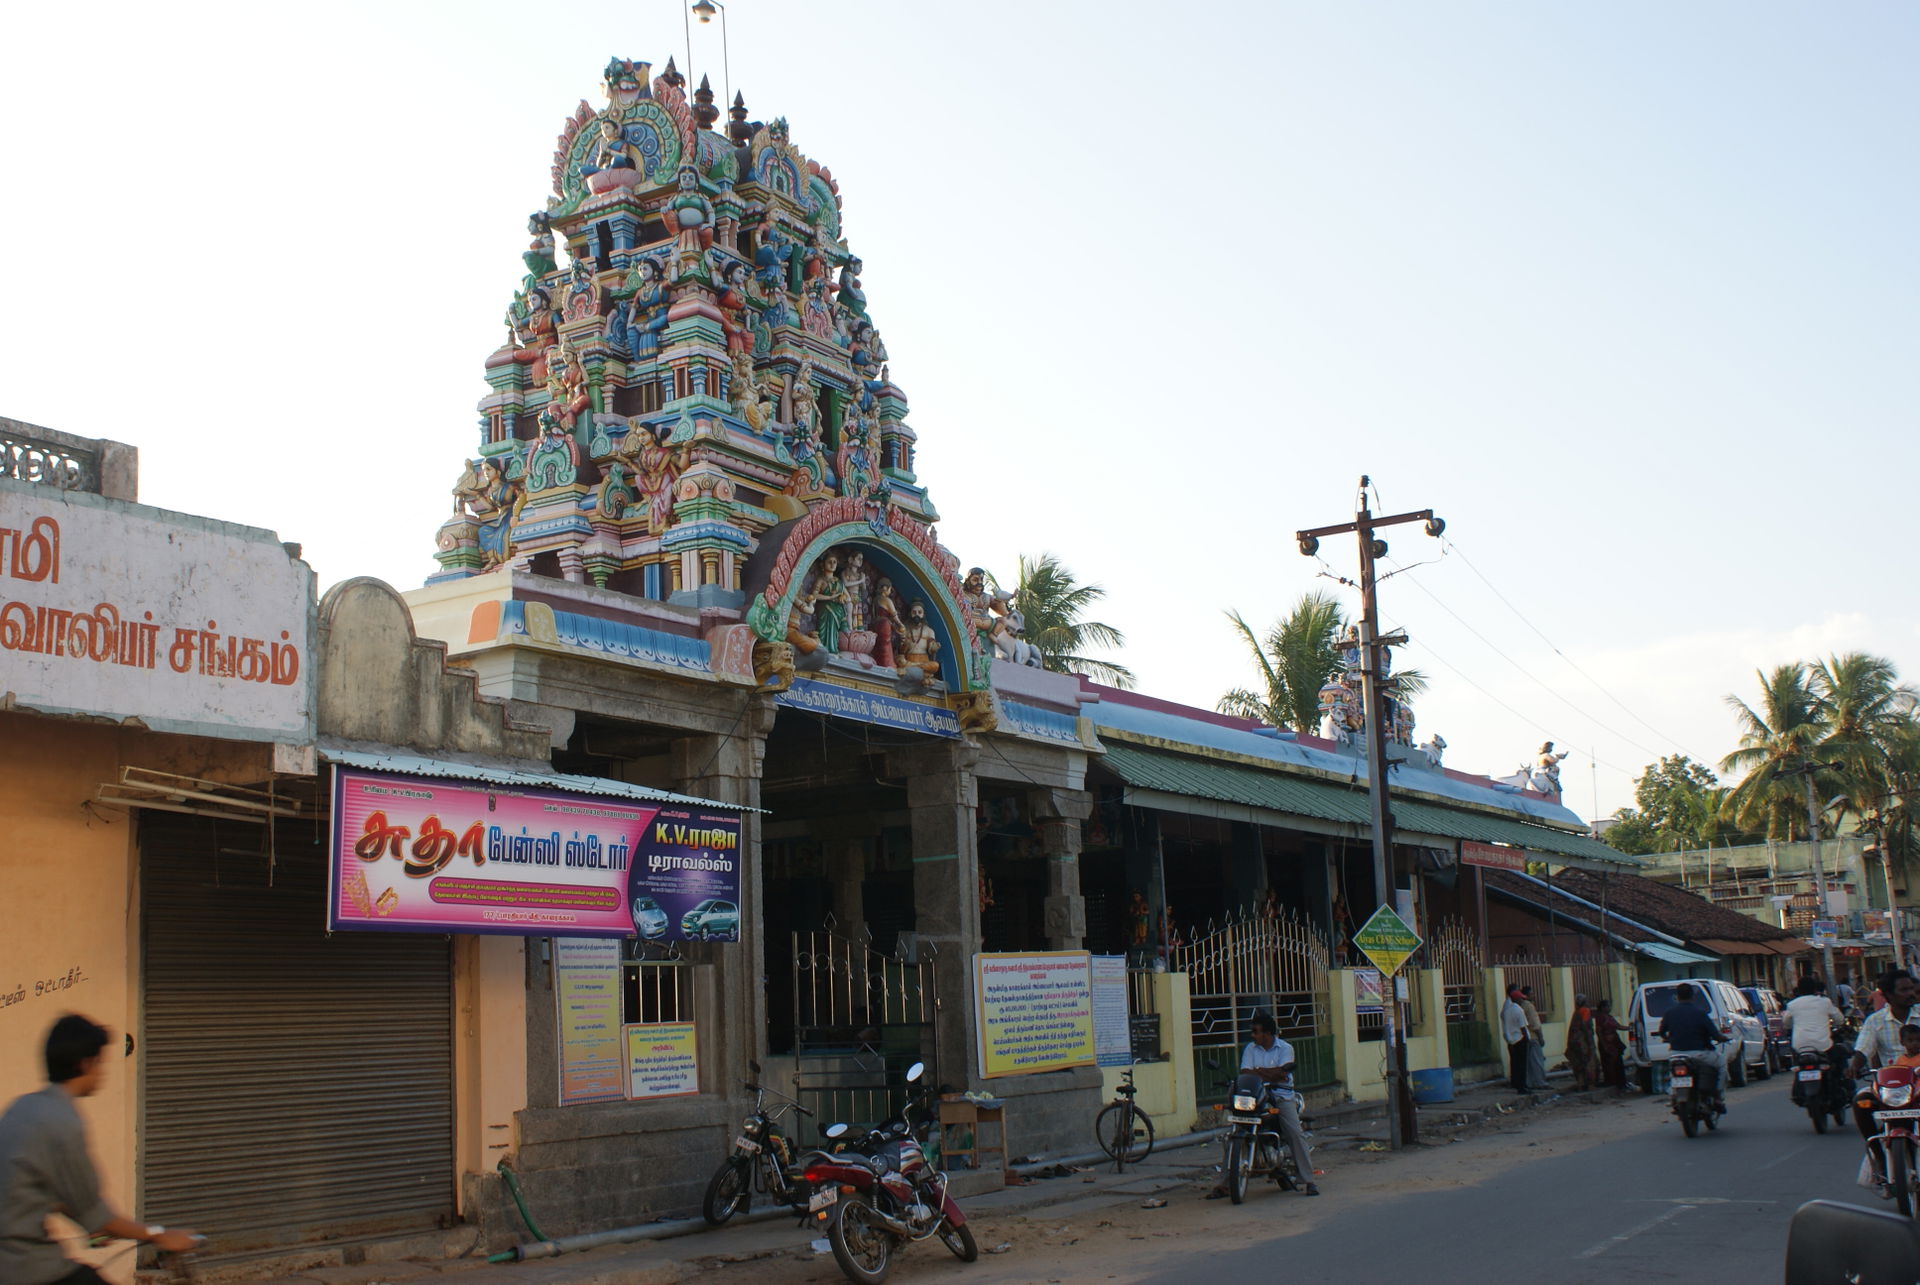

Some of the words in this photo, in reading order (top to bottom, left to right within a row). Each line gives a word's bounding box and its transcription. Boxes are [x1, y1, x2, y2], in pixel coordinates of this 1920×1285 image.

[169, 620, 299, 686] சங்கம்
[870, 700, 923, 726] அம்மையார்
[924, 711, 961, 733] ஆலயம்
[488, 825, 561, 866] பேன்ஸி
[565, 830, 630, 872] ஸ்டோர்
[655, 823, 738, 850] K.V.ராஜா
[648, 852, 733, 873] டிராவல்ஸ்
